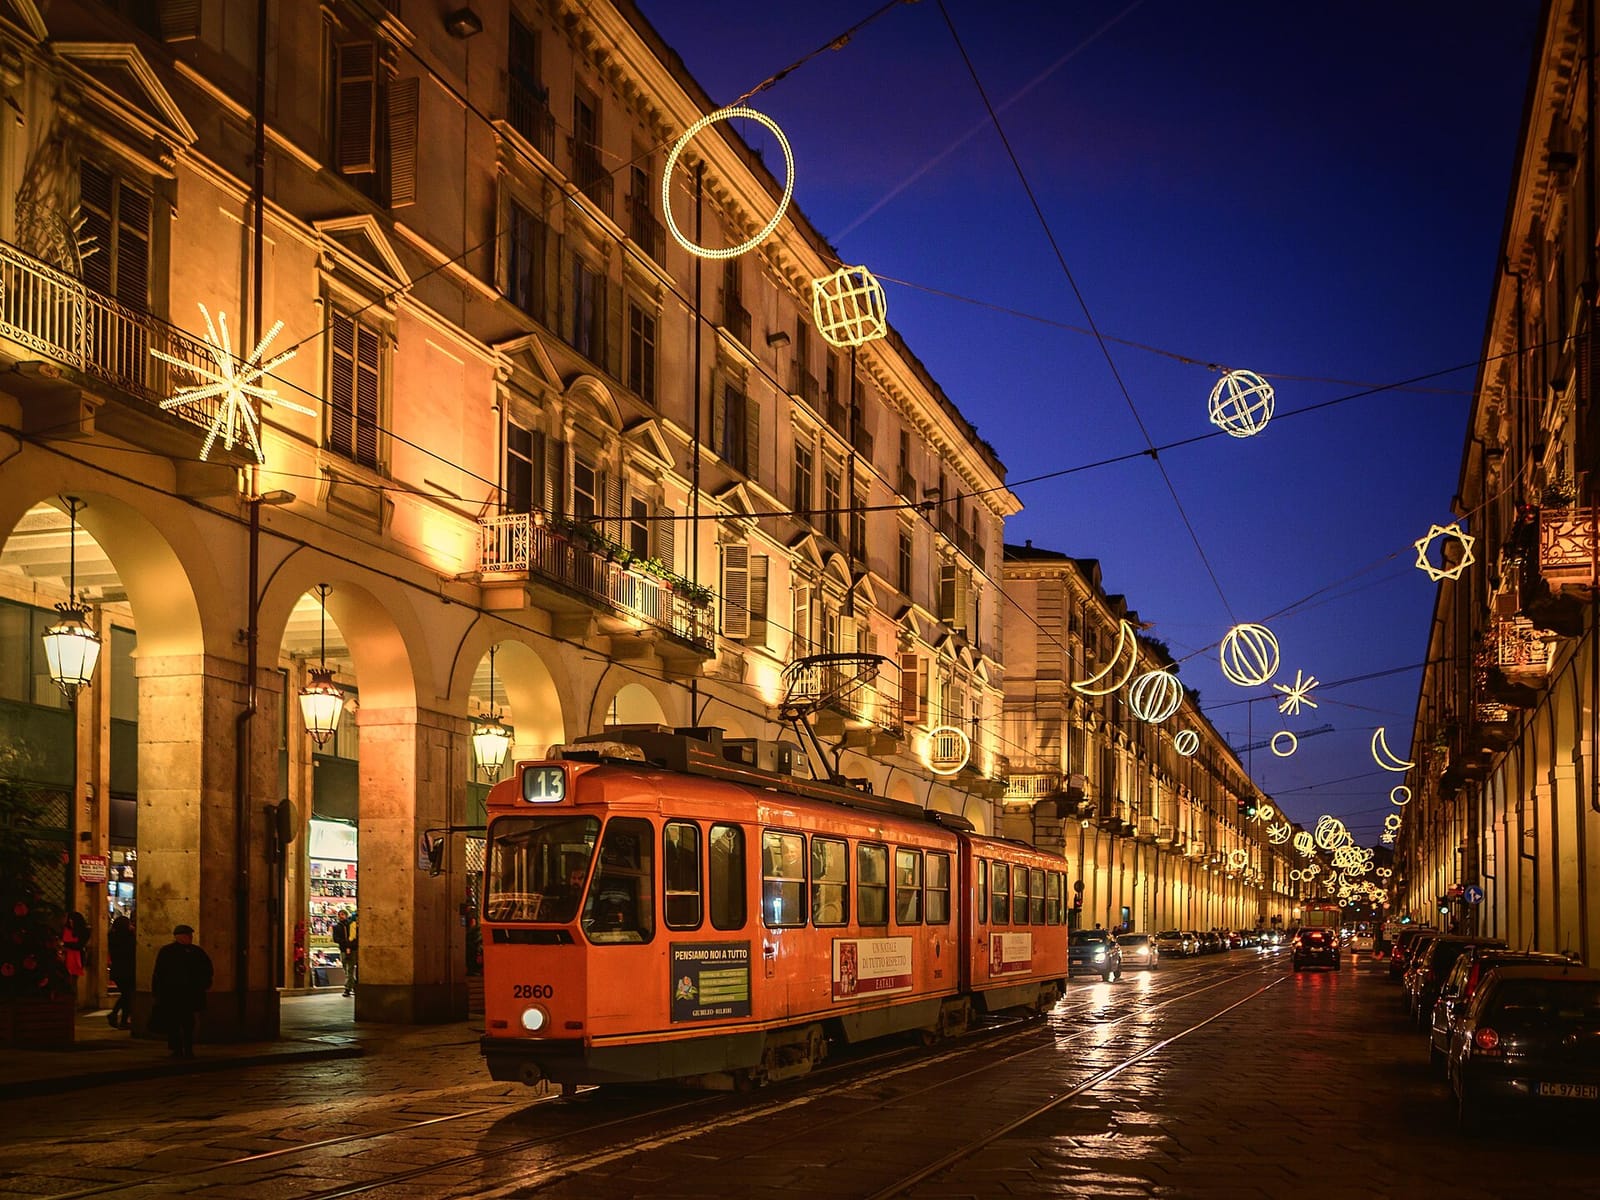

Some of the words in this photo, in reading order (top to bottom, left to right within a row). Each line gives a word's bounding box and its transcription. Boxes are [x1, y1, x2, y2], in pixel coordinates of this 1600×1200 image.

[538, 771, 562, 799] 13
[675, 951, 709, 960] PENSIAMO
[710, 950, 721, 959] NOI
[722, 950, 727, 959] A
[728, 950, 748, 959] TUTTO
[869, 956, 885, 968] TUTTO
[513, 984, 553, 999] 2860
